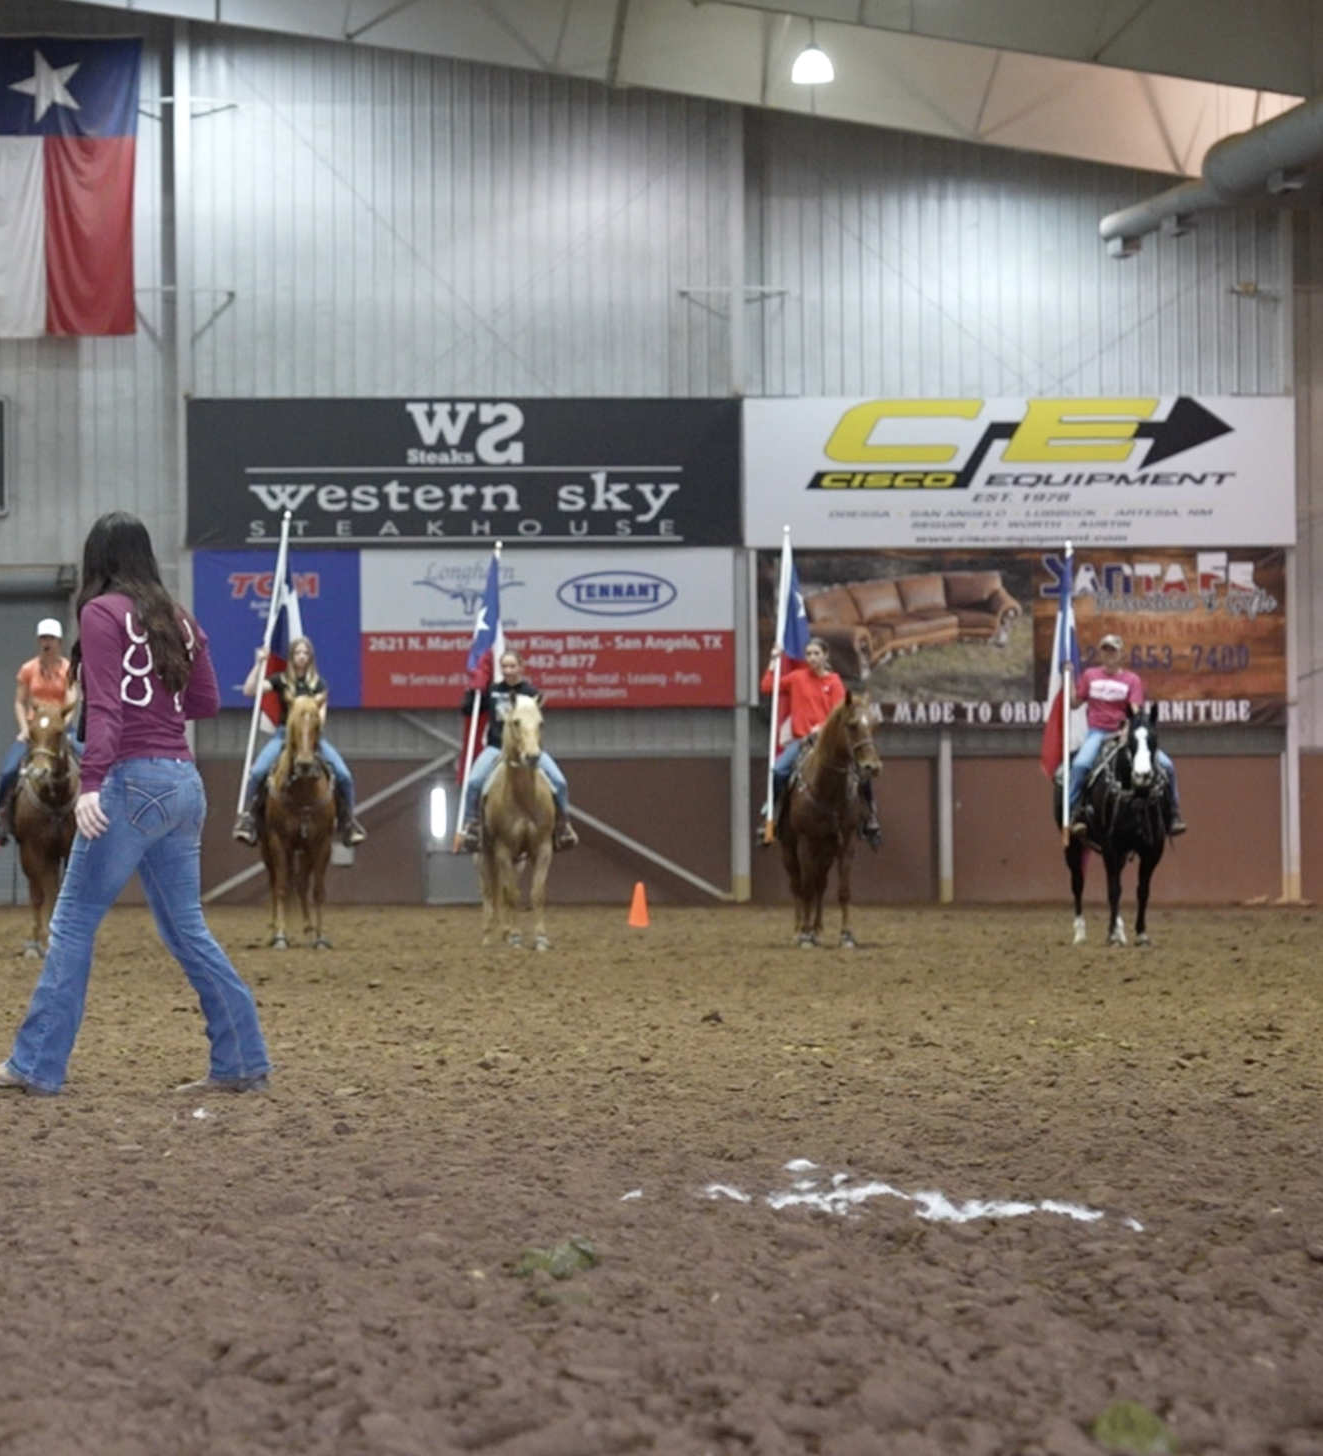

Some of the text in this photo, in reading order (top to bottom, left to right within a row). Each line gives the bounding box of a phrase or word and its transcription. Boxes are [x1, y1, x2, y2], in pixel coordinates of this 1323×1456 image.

[406, 448, 475, 464] Steaks
[820, 472, 958, 489] CISCO
[984, 472, 1237, 488] EQUIPMENT
[248, 471, 680, 522] western sky
[249, 519, 675, 537] STEAKHOUSE
[425, 561, 515, 585] Longhrn
[1040, 551, 1260, 597] SANTA FE
[573, 582, 662, 603] TENNANT
[369, 636, 404, 650] 2621
[407, 636, 424, 650] N.
[529, 636, 564, 653] King
[566, 635, 603, 649] Blvd.
[614, 636, 642, 649] San
[645, 635, 700, 653] Angelo,
[703, 635, 722, 649] TX
[525, 655, 597, 669] -482-8877
[894, 702, 955, 723] MADE
[961, 702, 992, 723] TO
[1000, 701, 1048, 723] ORD
[1144, 700, 1251, 722] RNITURE
